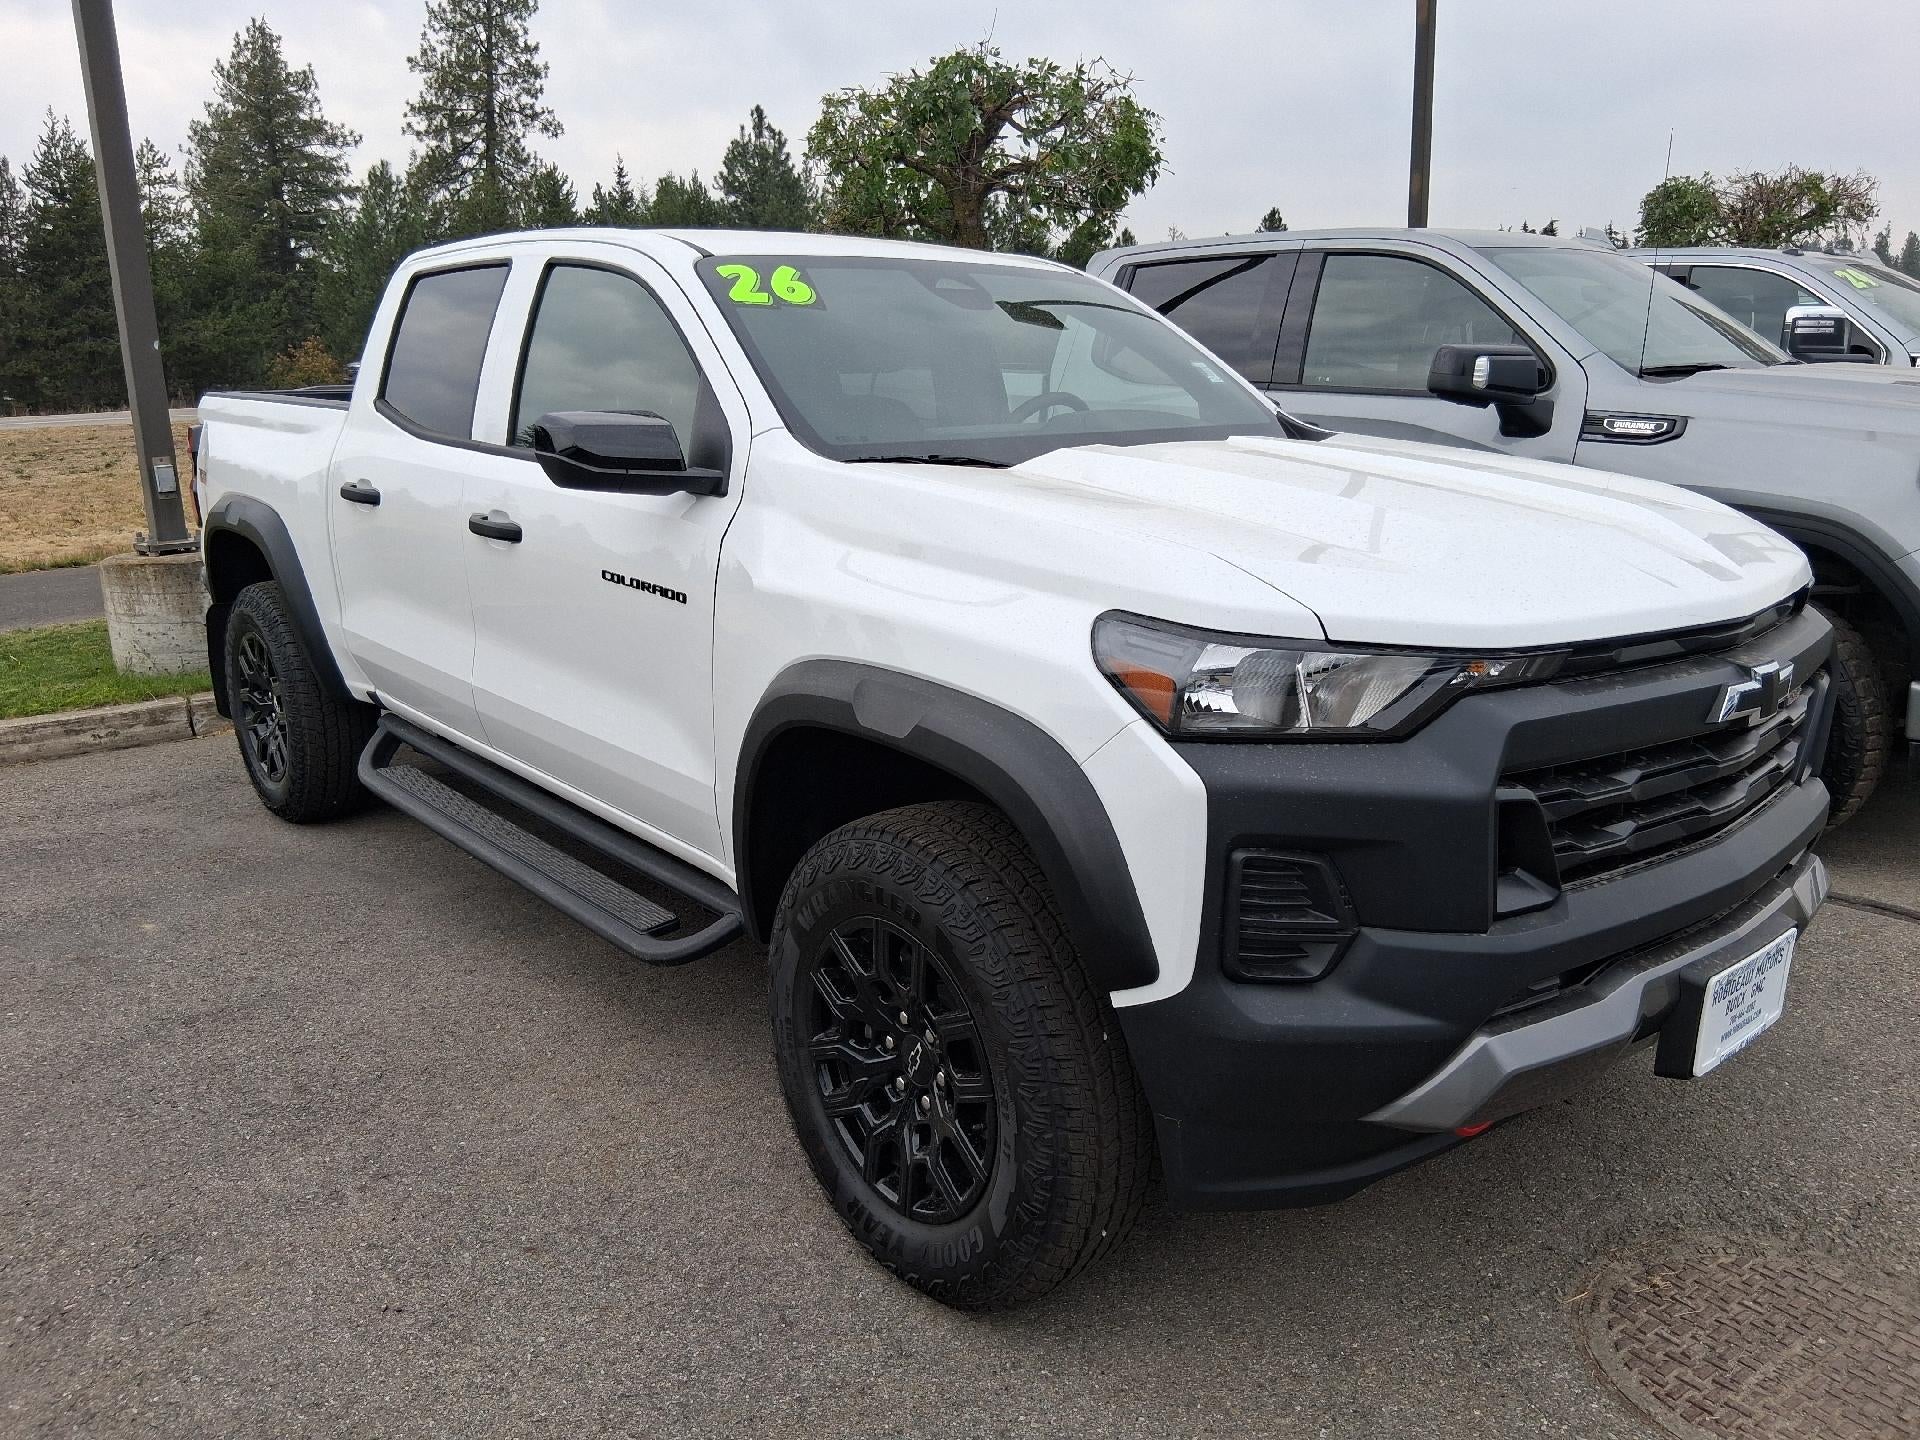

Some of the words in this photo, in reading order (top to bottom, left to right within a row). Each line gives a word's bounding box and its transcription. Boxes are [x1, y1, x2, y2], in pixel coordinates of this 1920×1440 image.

[716, 264, 817, 305] 26
[1613, 421, 1657, 430] DURAMAX
[601, 569, 687, 605] COLORADO
[1755, 946, 1785, 979] MOTORS
[1725, 988, 1747, 1016] BUICK
[1750, 976, 1766, 998] GMC
